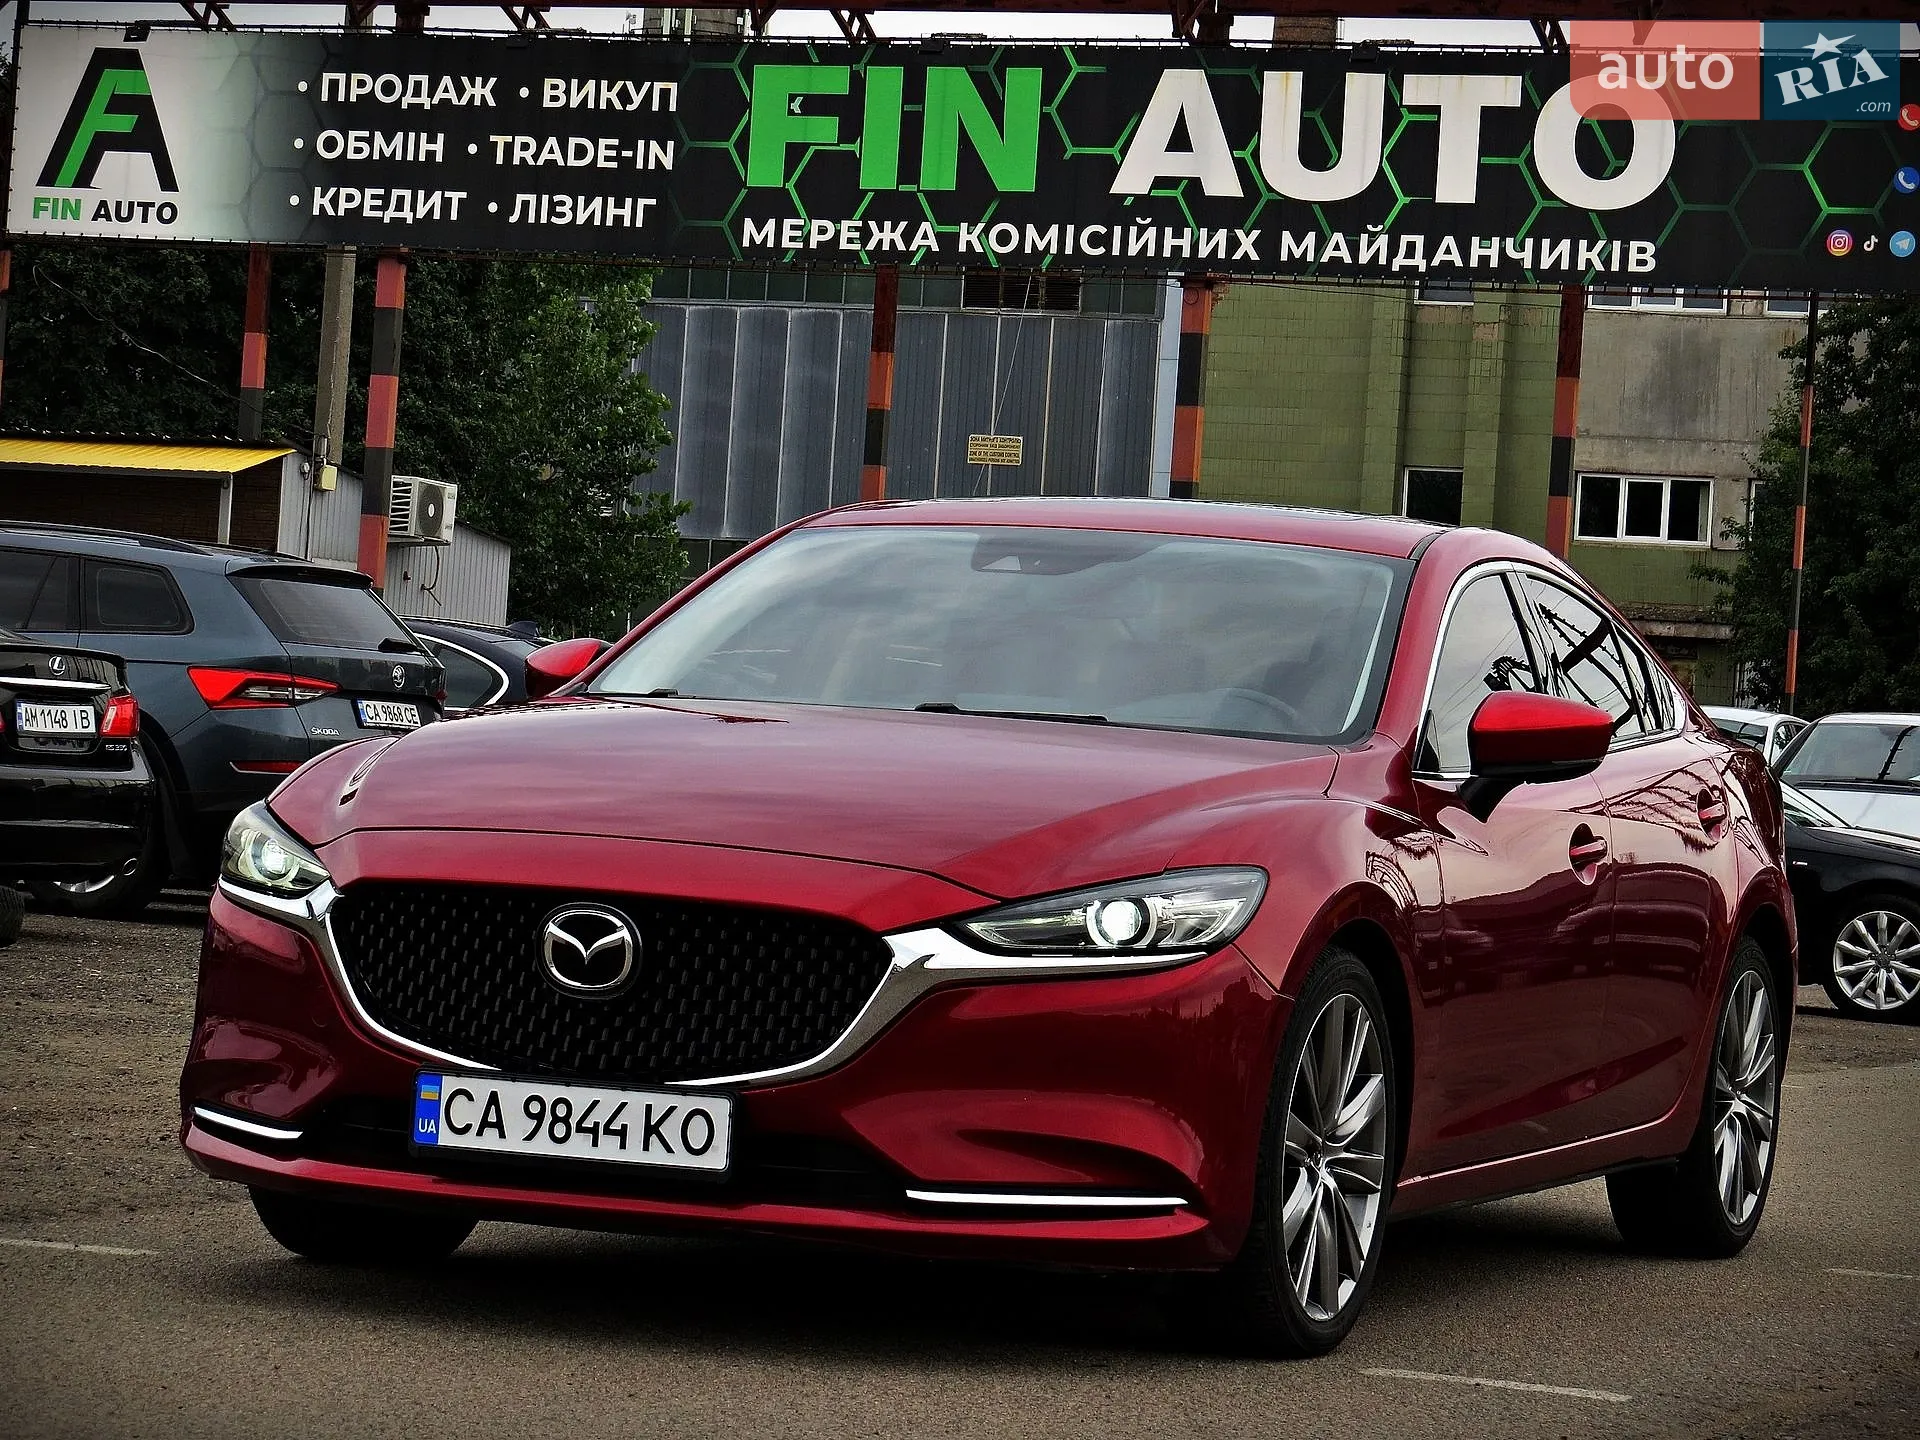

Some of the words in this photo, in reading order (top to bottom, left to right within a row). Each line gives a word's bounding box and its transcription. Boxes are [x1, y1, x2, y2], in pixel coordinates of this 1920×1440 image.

[320, 72, 498, 110] ПРОДАЖ
[542, 78, 679, 113] ВИКУП
[316, 129, 445, 163] ОБМІН
[489, 134, 675, 171] TRADE-IN
[746, 64, 1042, 192] FIN
[1109, 69, 1676, 211] AUTO
[32, 197, 82, 220] FIN
[91, 200, 178, 225] AUTO
[312, 186, 468, 222] КРЕДИТ
[508, 193, 657, 228] ЛІЗИНГ
[742, 217, 940, 252] МЕРЕЖА
[958, 217, 1262, 261] КОМІСІЙНИХ
[1280, 224, 1656, 273] МАЙДАНЧИКІВ
[25, 707, 39, 728] AM
[40, 709, 68, 729] 1148
[73, 709, 91, 730] IB
[365, 703, 381, 721] CA
[404, 707, 419, 725] CE
[418, 1118, 437, 1134] UA
[444, 1088, 507, 1139] CA
[521, 1094, 628, 1150] 9844
[642, 1104, 715, 1156] KO
